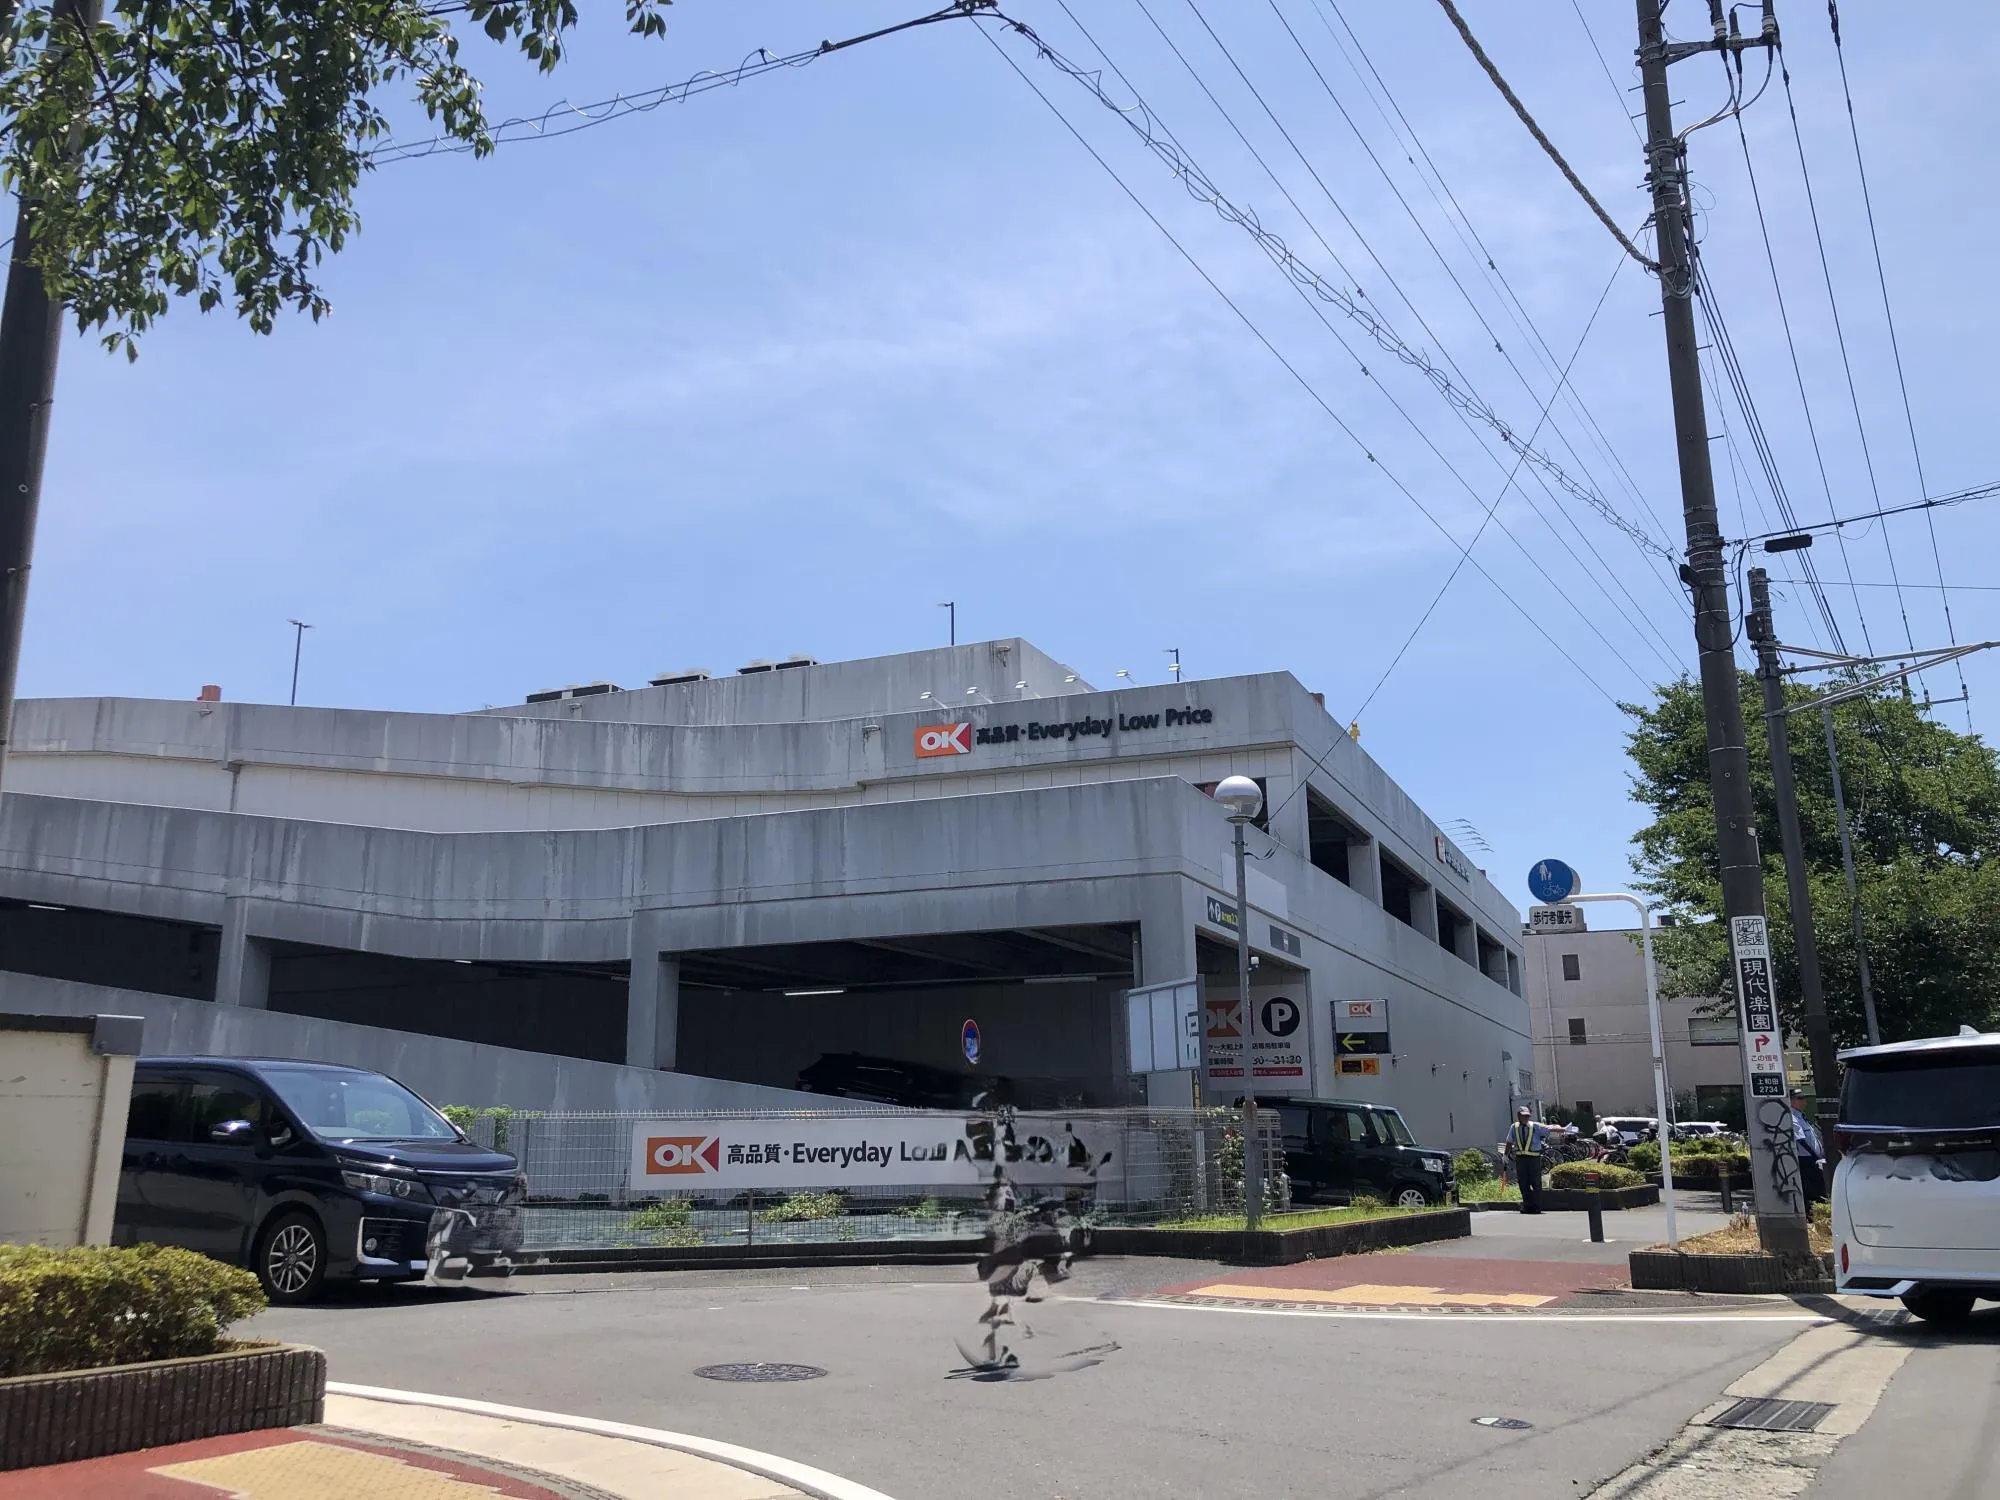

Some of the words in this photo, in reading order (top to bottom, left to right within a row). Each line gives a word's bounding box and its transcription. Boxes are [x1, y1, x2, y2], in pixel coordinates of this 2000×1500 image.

[919, 722, 971, 754] OK
[1119, 713, 1160, 731] Low
[1165, 706, 1213, 727] Price
[1533, 910, 1573, 925] 歩行者優先
[1736, 948, 1768, 956] HOTEL
[1351, 1003, 1372, 1016] OK
[1743, 960, 1770, 1030] 現代楽園
[1270, 1003, 1293, 1032] P
[654, 1136, 720, 1174] OK
